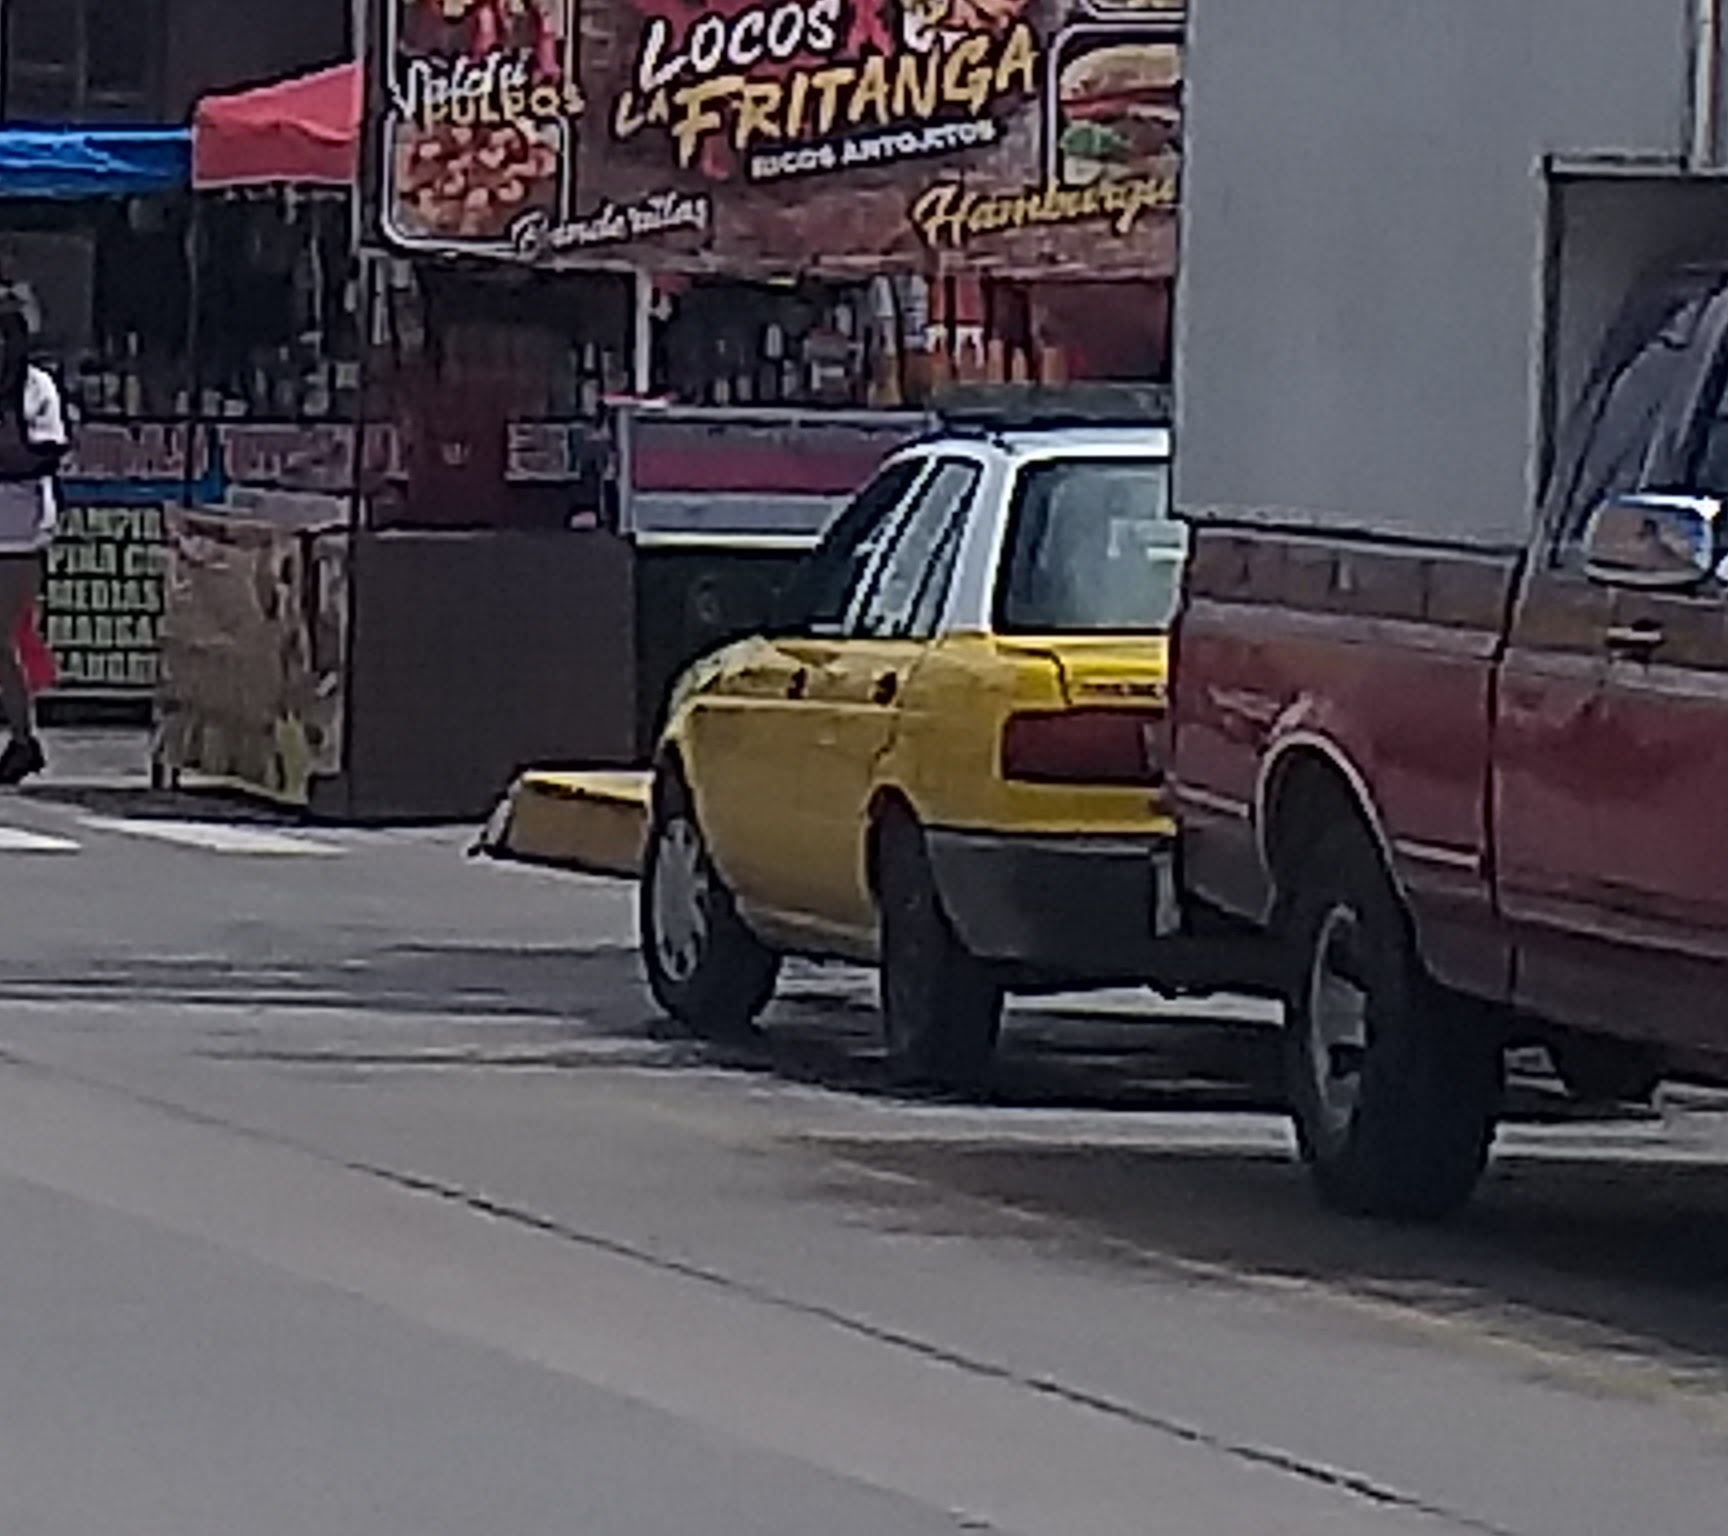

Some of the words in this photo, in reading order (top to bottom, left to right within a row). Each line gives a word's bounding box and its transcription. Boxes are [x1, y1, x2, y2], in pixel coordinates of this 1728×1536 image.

[614, 86, 671, 141] LA
[671, 22, 1039, 169] FRITANGA
[750, 147, 836, 178] RICOS
[841, 119, 996, 165] ANTOJITOS
[912, 176, 1176, 247] Hamburgu
